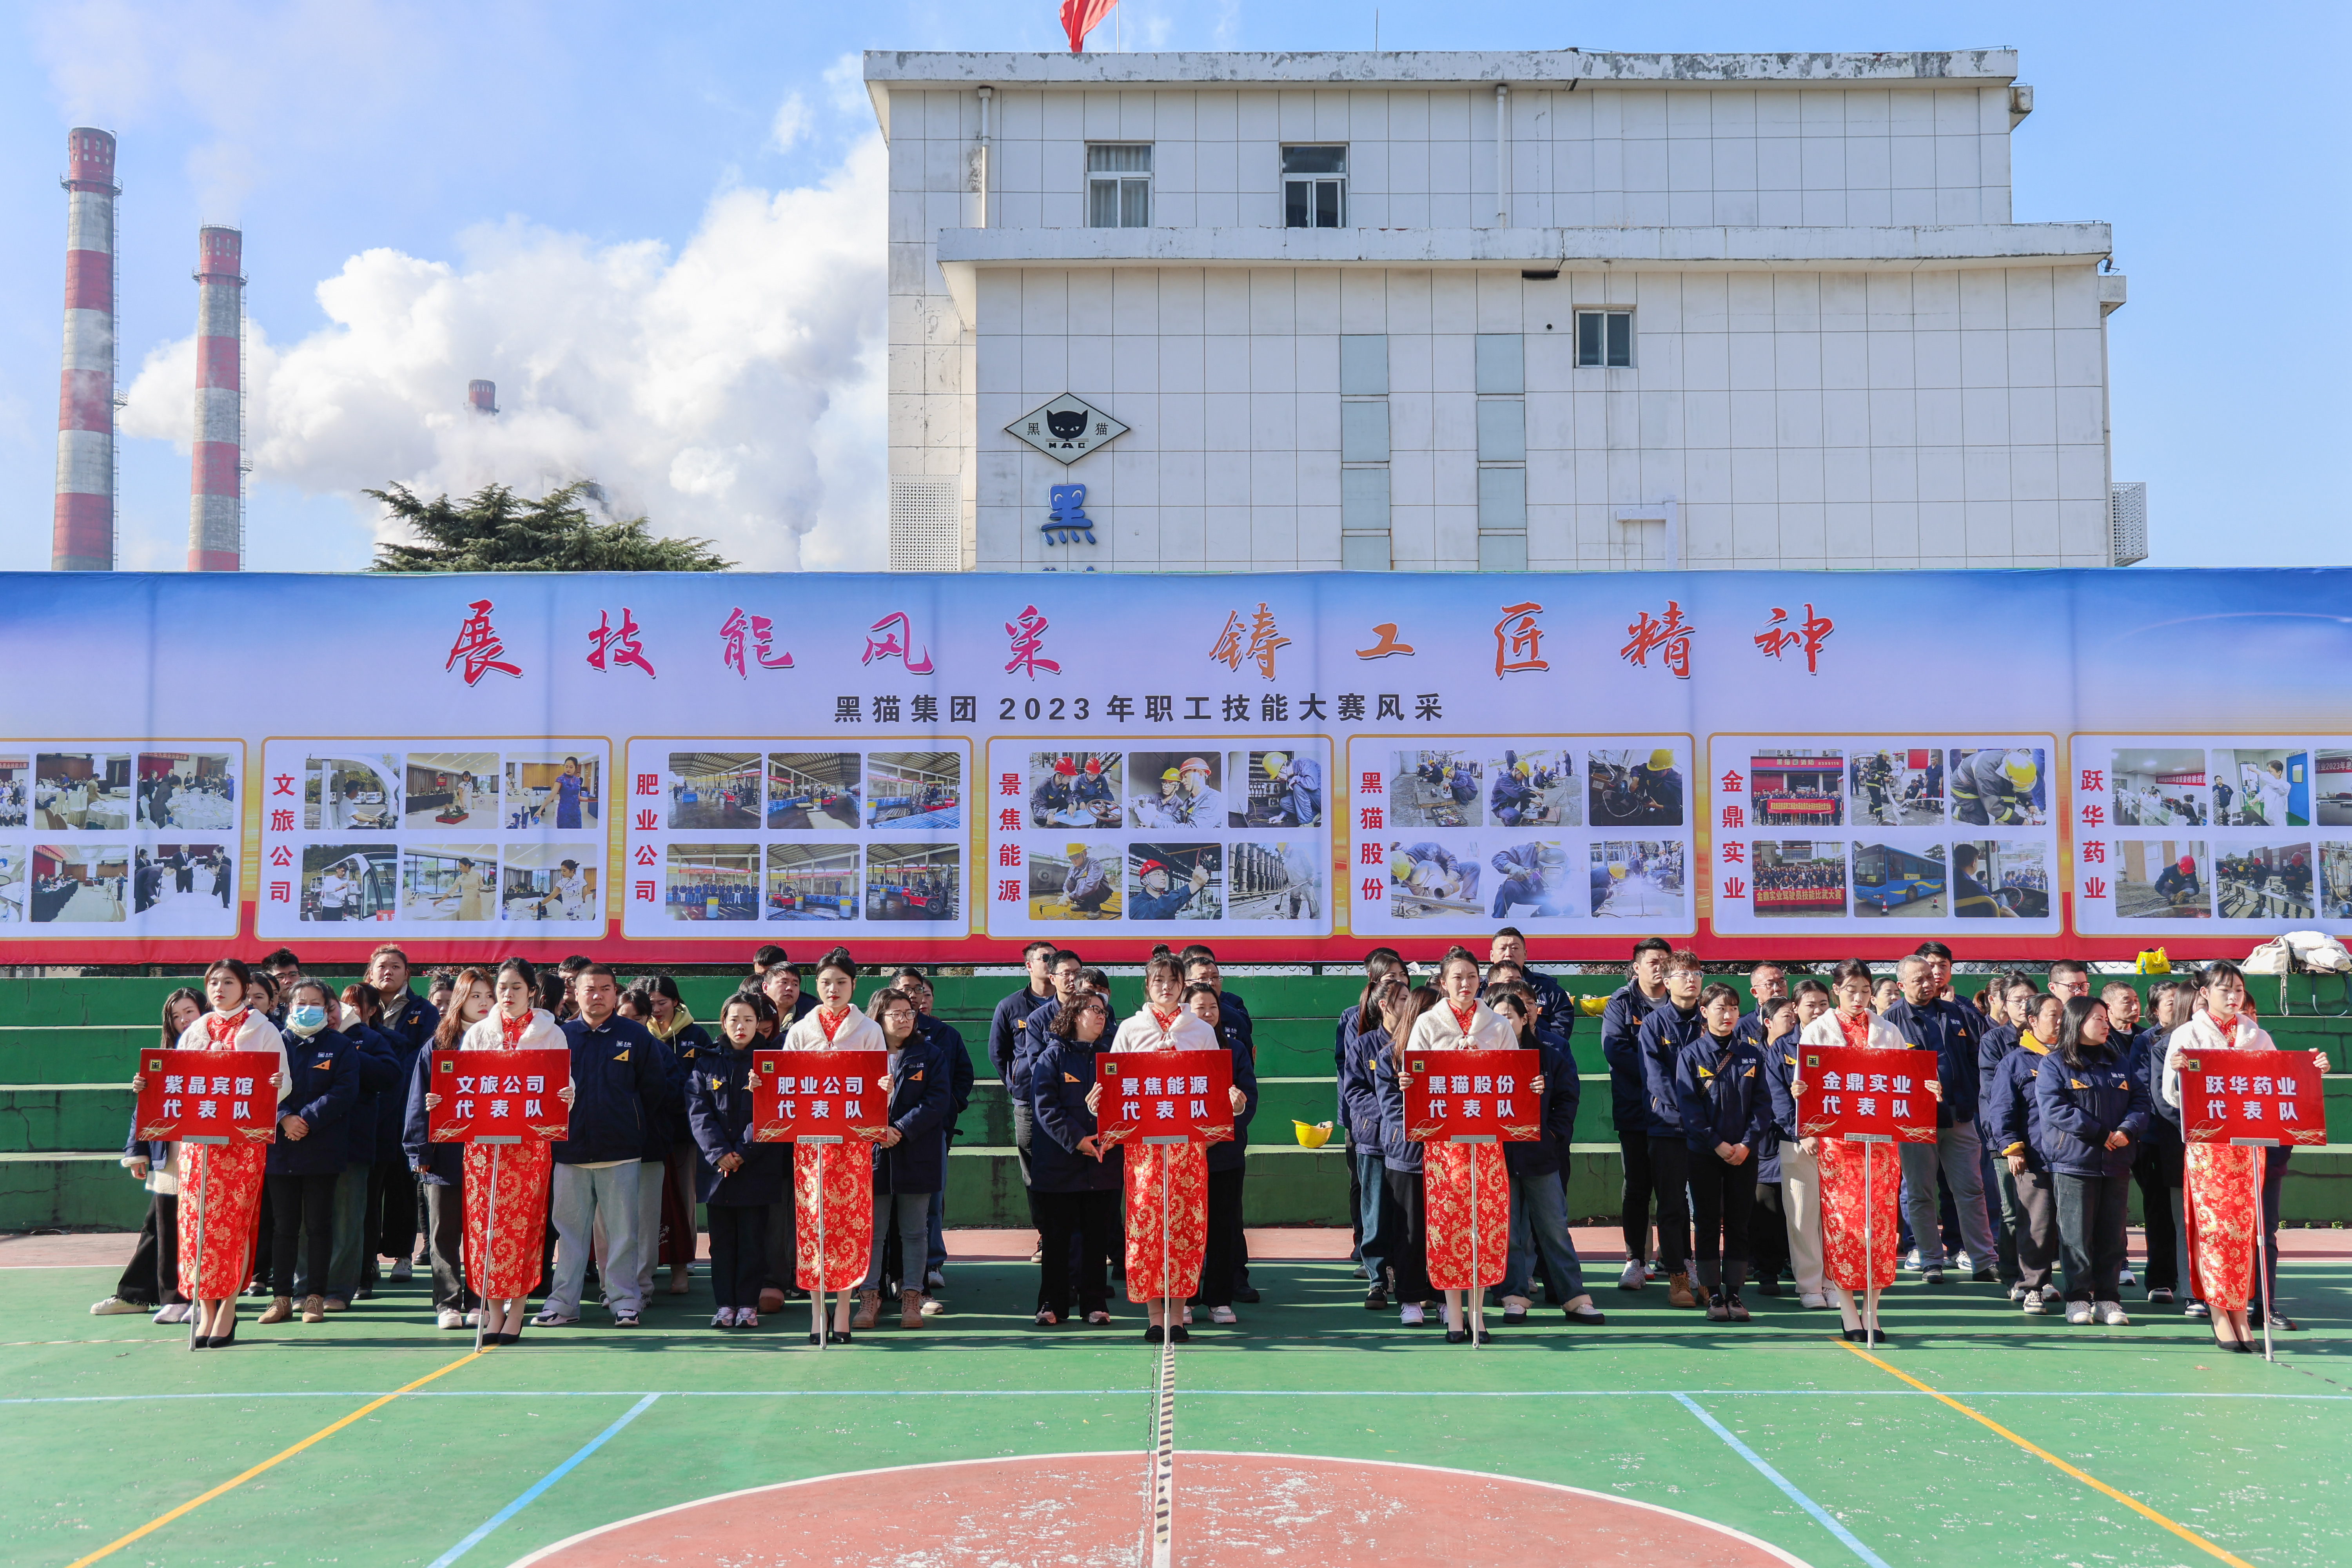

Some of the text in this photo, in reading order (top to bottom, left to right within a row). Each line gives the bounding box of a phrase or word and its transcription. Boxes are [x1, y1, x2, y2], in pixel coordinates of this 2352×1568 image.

[1027, 422, 1108, 436] 黑 猫
[1039, 483, 1096, 571] 黑
[445, 599, 1834, 685] 展技能风采 铸工匠精神
[834, 693, 1442, 723] 黑猫集团 2023 年职工技能大赛风采
[270, 773, 295, 903] 文旅公司
[635, 774, 659, 902] 肥业公司
[998, 773, 1022, 902] 景焦能源
[1360, 772, 1384, 900] 黑猫股份
[1721, 769, 1746, 899] 金鼎实业
[2081, 769, 2106, 898] 跃华药业
[1757, 889, 1842, 901] 金鼎实业驾驶员技能比武大赛
[164, 1075, 253, 1095] 紫晶宾馆
[456, 1075, 544, 1094] 文旅公司
[777, 1076, 863, 1095] 肥业公司
[1122, 1076, 1208, 1096] 景焦能源
[1428, 1075, 1514, 1094] 黑猫股份
[1822, 1071, 1911, 1094] 金鼎实业
[2206, 1076, 2297, 1096] 跃华药业
[163, 1099, 251, 1120] 代表队
[456, 1099, 543, 1118] 代表队
[777, 1100, 863, 1119] 代表队
[1122, 1100, 1208, 1120] 代表队
[1428, 1099, 1514, 1118] 代表队
[1822, 1095, 1910, 1118] 代表队
[2207, 1100, 2298, 1121] 代表队
